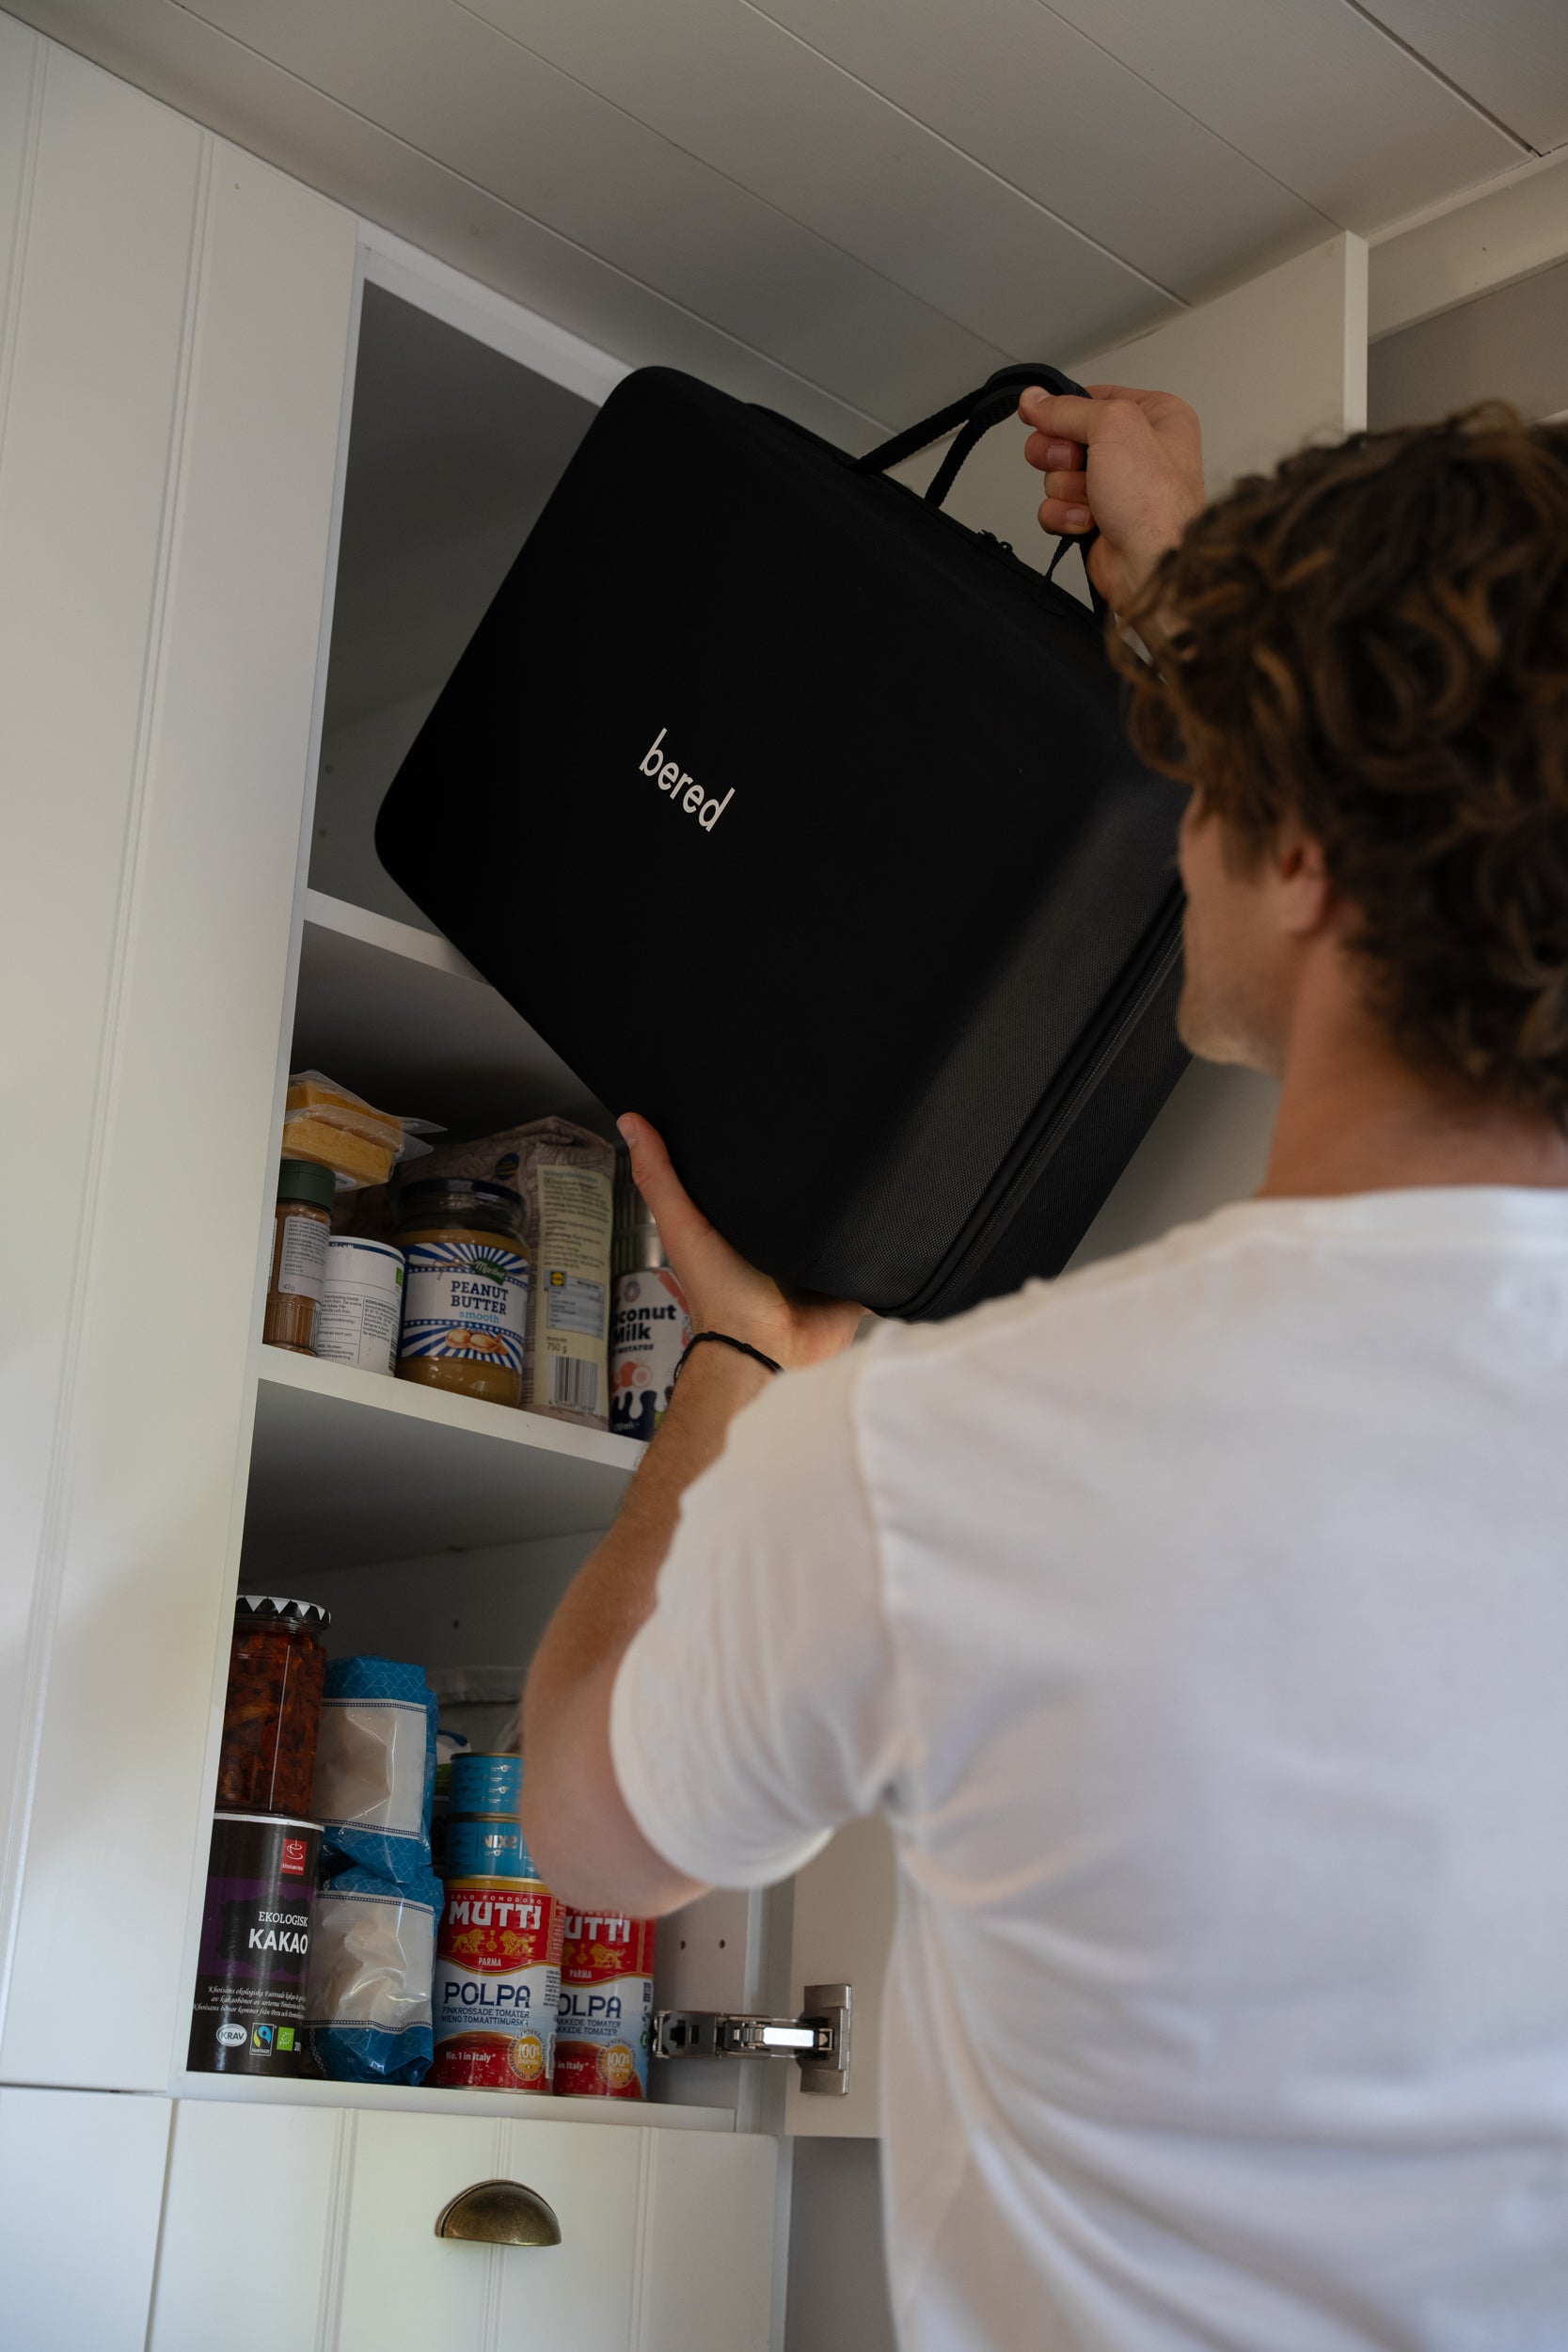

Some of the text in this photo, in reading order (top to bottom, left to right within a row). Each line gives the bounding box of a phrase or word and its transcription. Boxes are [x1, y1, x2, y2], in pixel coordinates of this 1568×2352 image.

[639, 727, 736, 833] bered
[451, 1280, 509, 1301] PEANUT
[451, 1295, 506, 1315] BUTTER
[459, 1311, 499, 1324] smooth
[612, 1304, 676, 1325] conut
[258, 1911, 309, 1928] EKOLOGISK
[449, 1900, 543, 1931] MUTTI
[563, 1915, 631, 1943] UTTI
[248, 1928, 309, 1955] KAKAO
[478, 1957, 502, 1967] PARMA
[569, 1969, 593, 1979] PARMA
[443, 1981, 531, 2009] POLPA
[442, 2007, 531, 2019] FINKROSSADE TOMATER
[558, 1993, 622, 2018] OLPA
[584, 2027, 618, 2037] TOMATER
[587, 2019, 622, 2028] TOMATER
[221, 2032, 245, 2041] KRAV
[445, 2051, 457, 2059] No.
[464, 2052, 471, 2060] in
